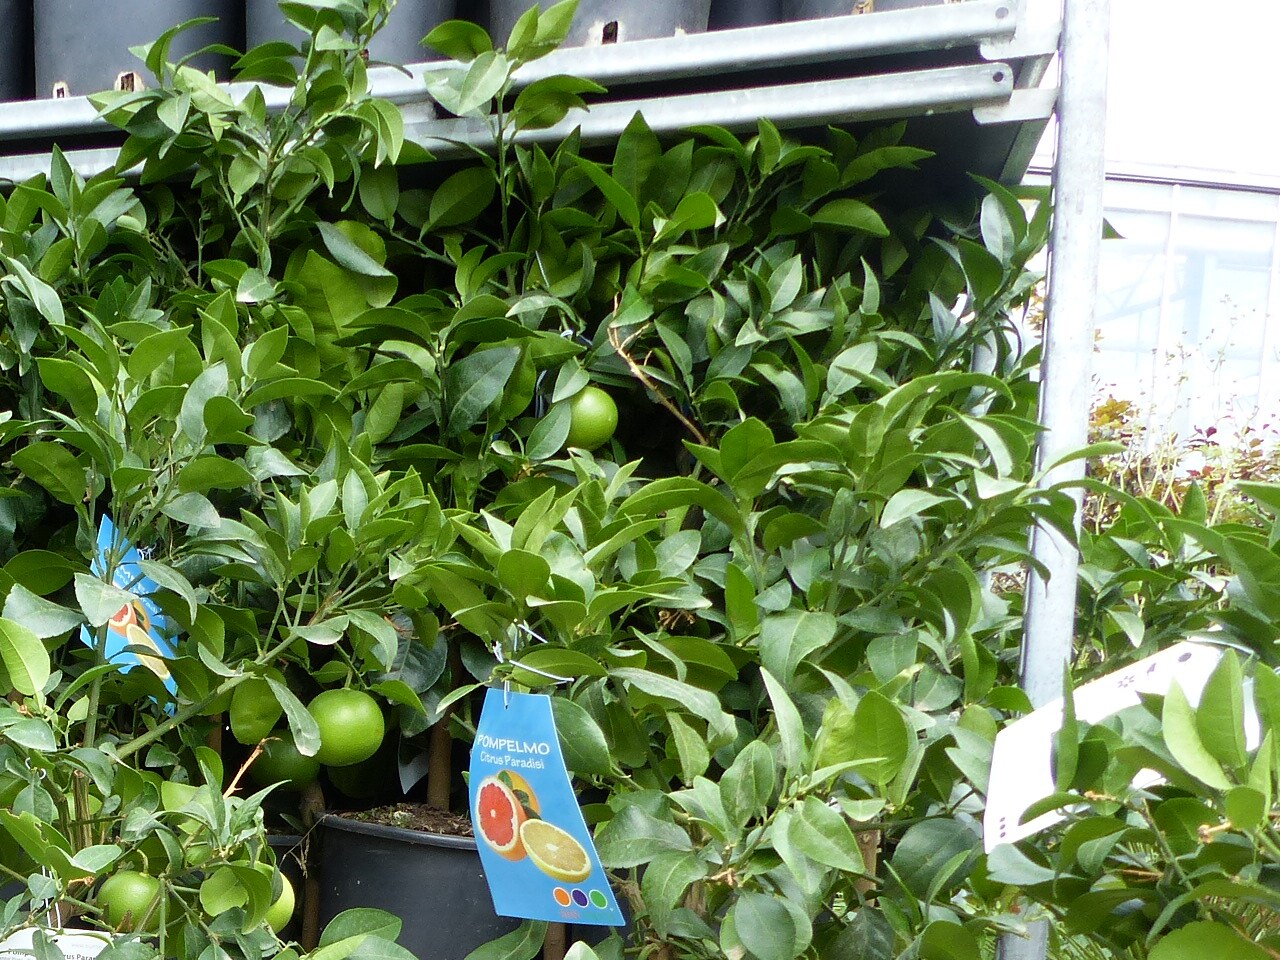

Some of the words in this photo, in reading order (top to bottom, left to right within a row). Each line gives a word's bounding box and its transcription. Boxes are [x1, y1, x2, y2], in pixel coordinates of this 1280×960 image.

[477, 734, 550, 755] POMPELMO
[480, 751, 504, 765] Citrus
[504, 755, 545, 769] Paradisi
